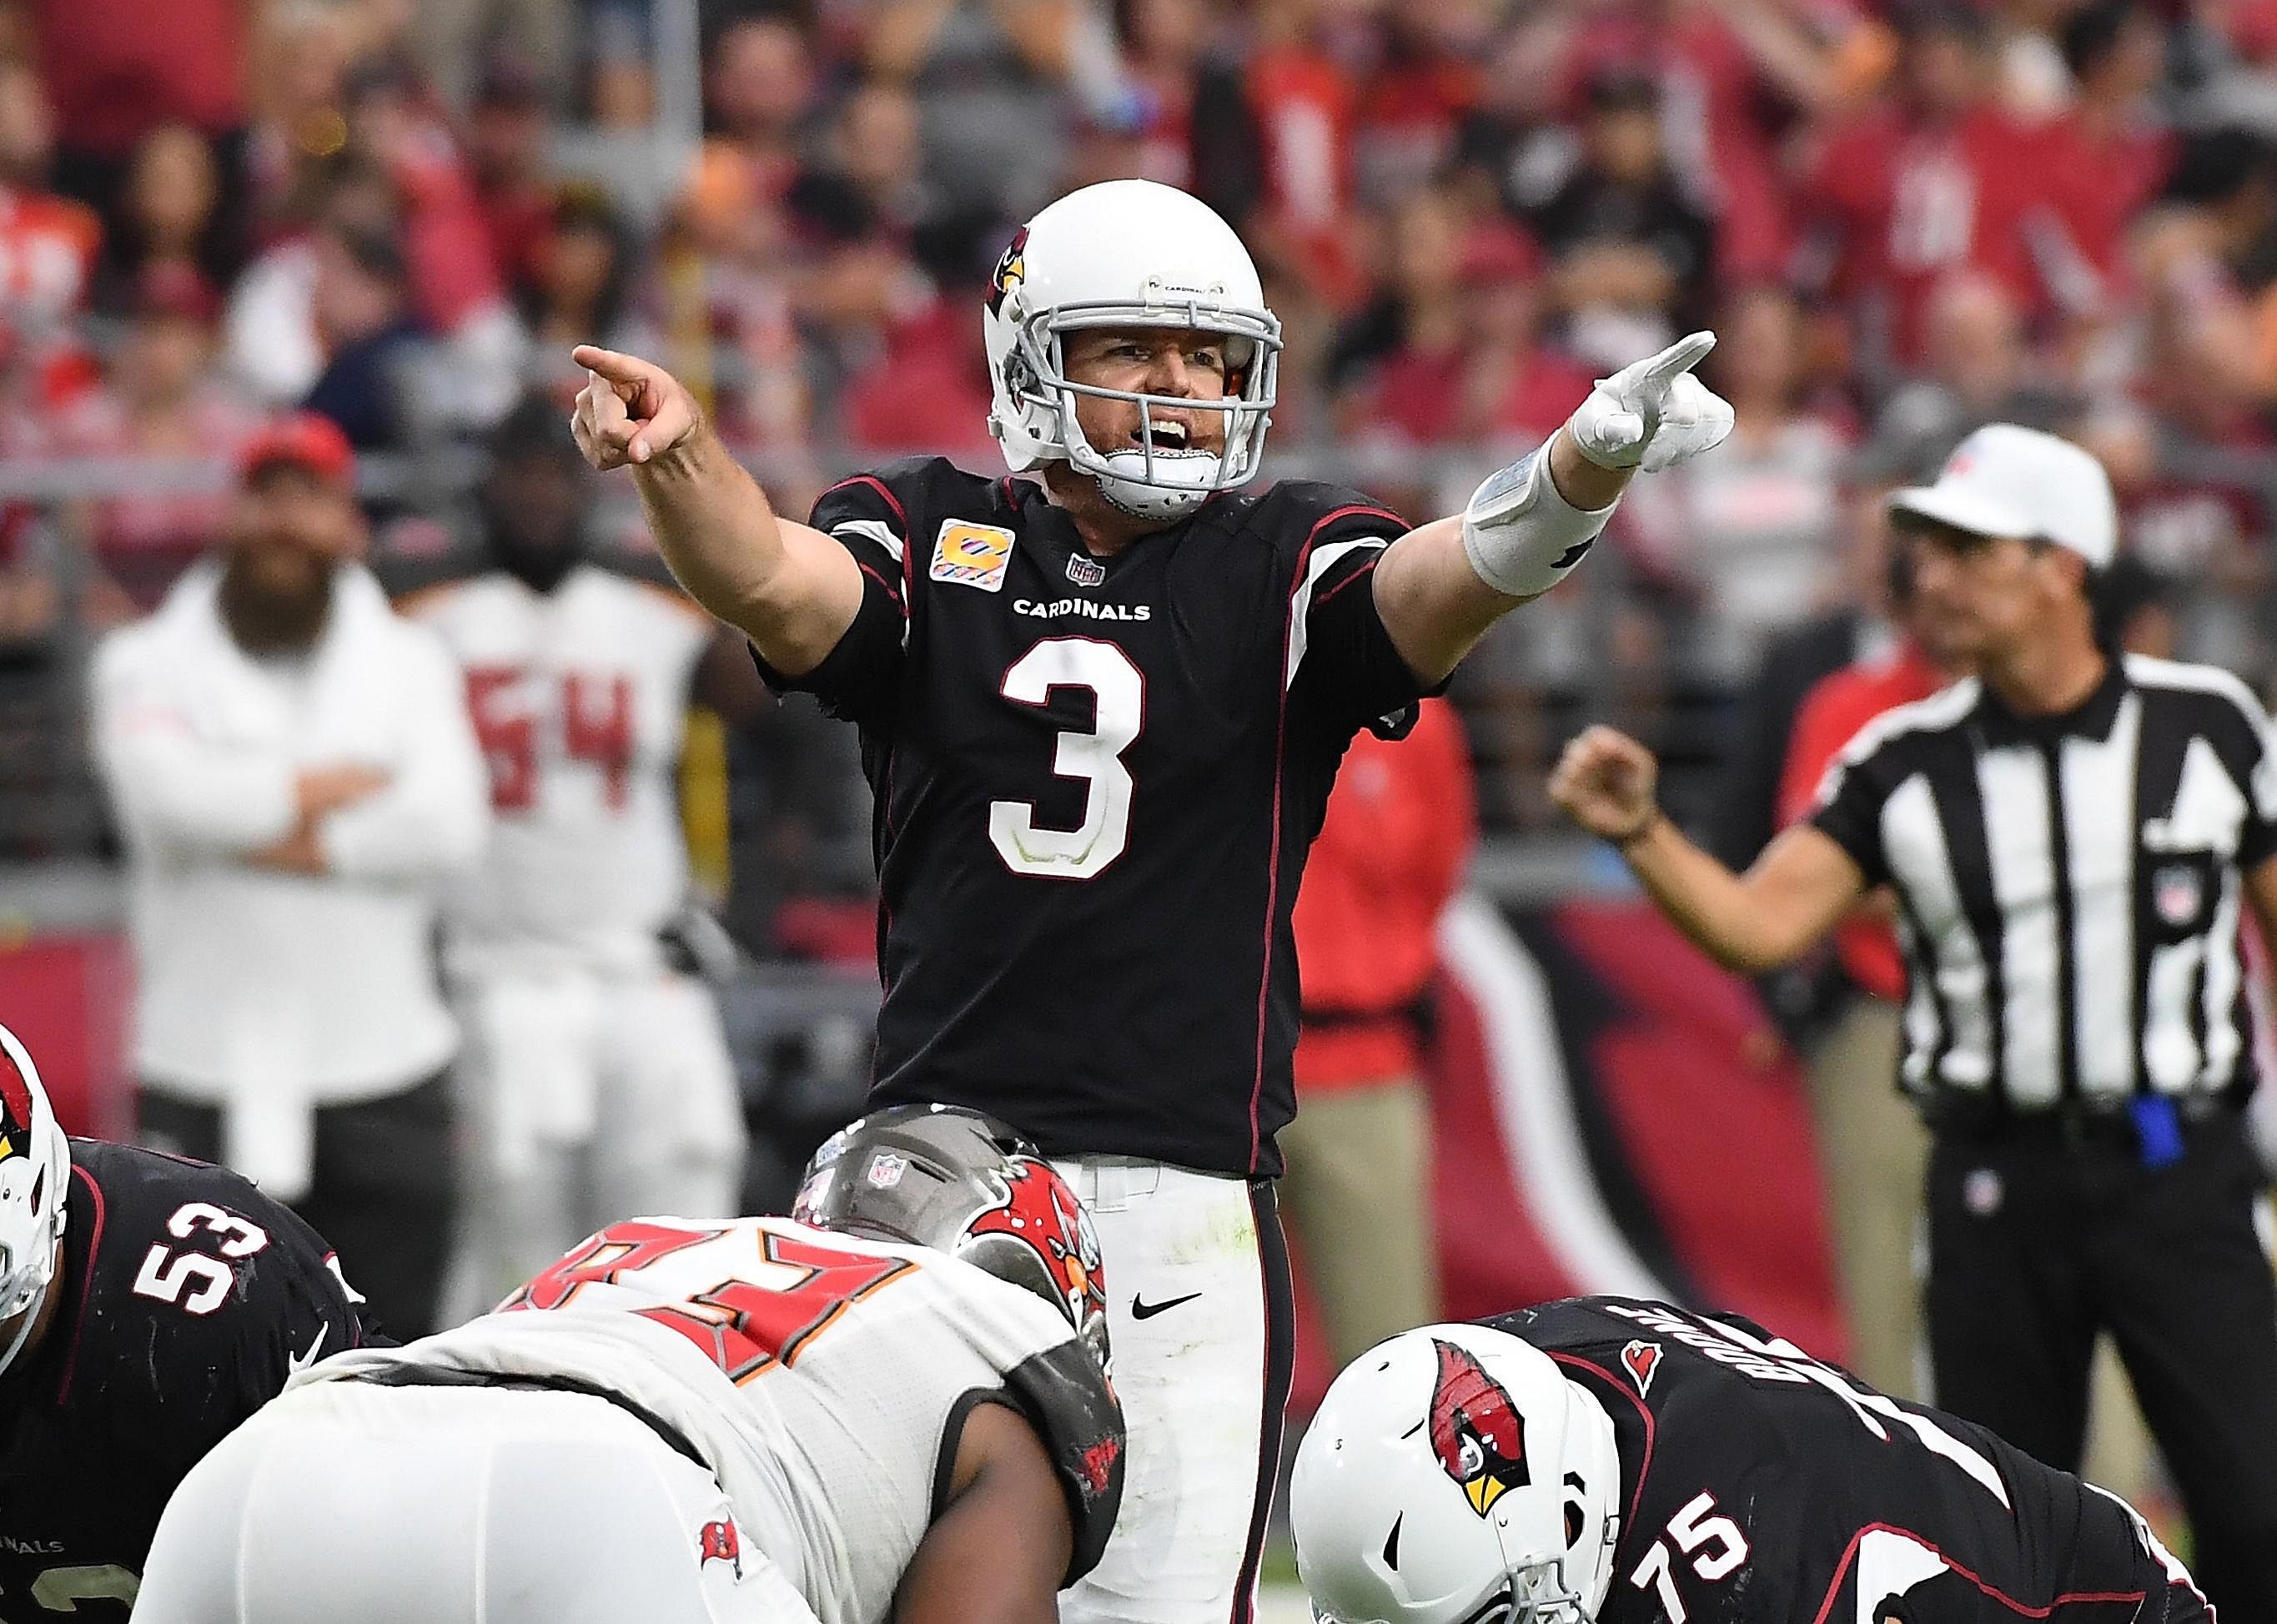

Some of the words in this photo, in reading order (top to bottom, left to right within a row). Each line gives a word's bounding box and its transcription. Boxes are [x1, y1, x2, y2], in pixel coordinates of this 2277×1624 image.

[942, 525, 1009, 571] C
[1013, 598, 1151, 621] CARDINALS
[464, 665, 633, 807] 54
[987, 635, 1147, 882] 3
[132, 1201, 272, 1316] 53
[1629, 1488, 1752, 1624] 75
